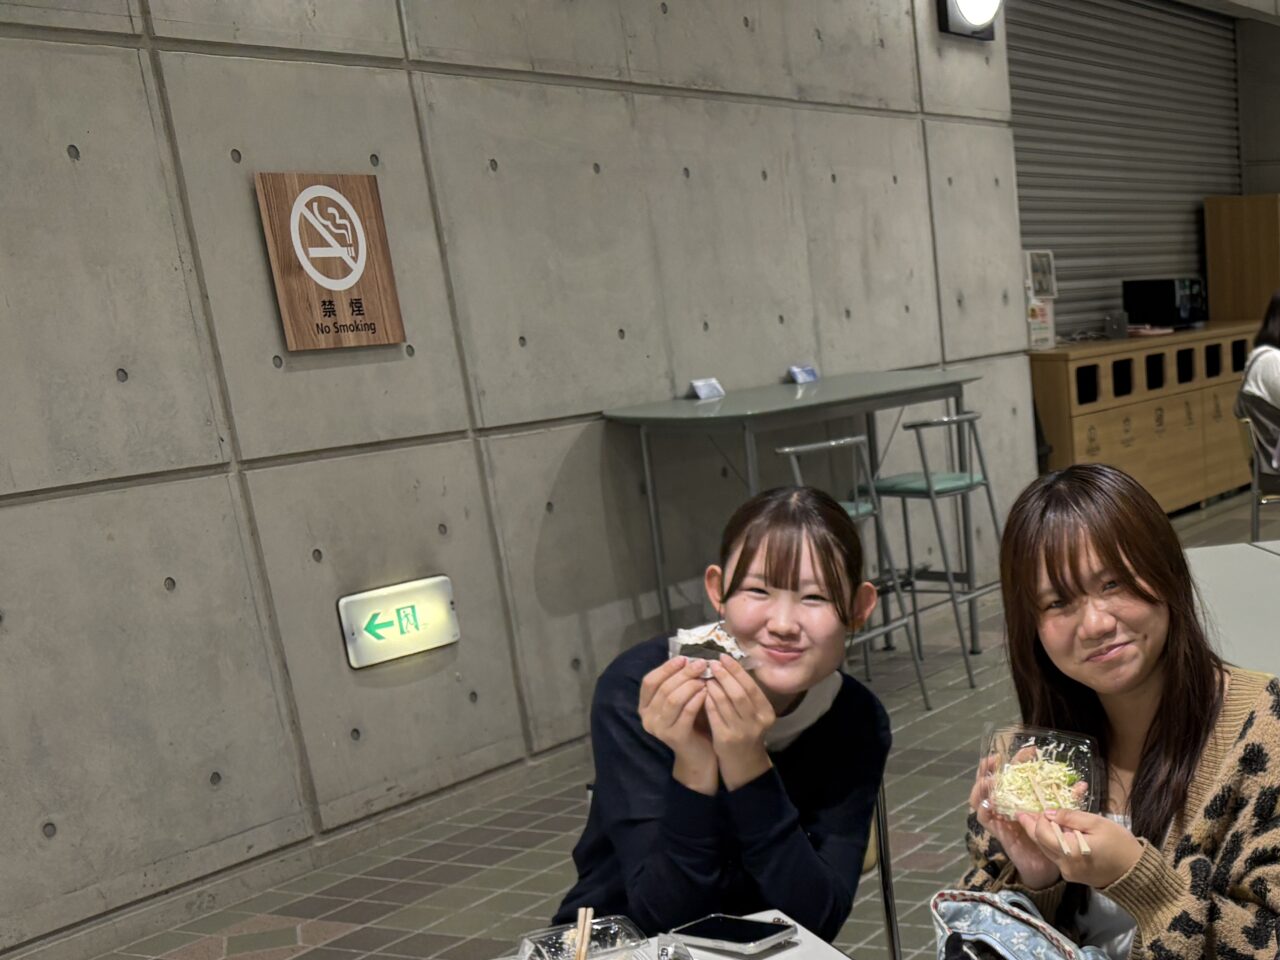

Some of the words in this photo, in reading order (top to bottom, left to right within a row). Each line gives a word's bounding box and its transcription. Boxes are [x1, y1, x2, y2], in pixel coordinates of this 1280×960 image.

[320, 298, 365, 318] 禁煙
[316, 322, 331, 335] No
[333, 320, 377, 335] Smoking
